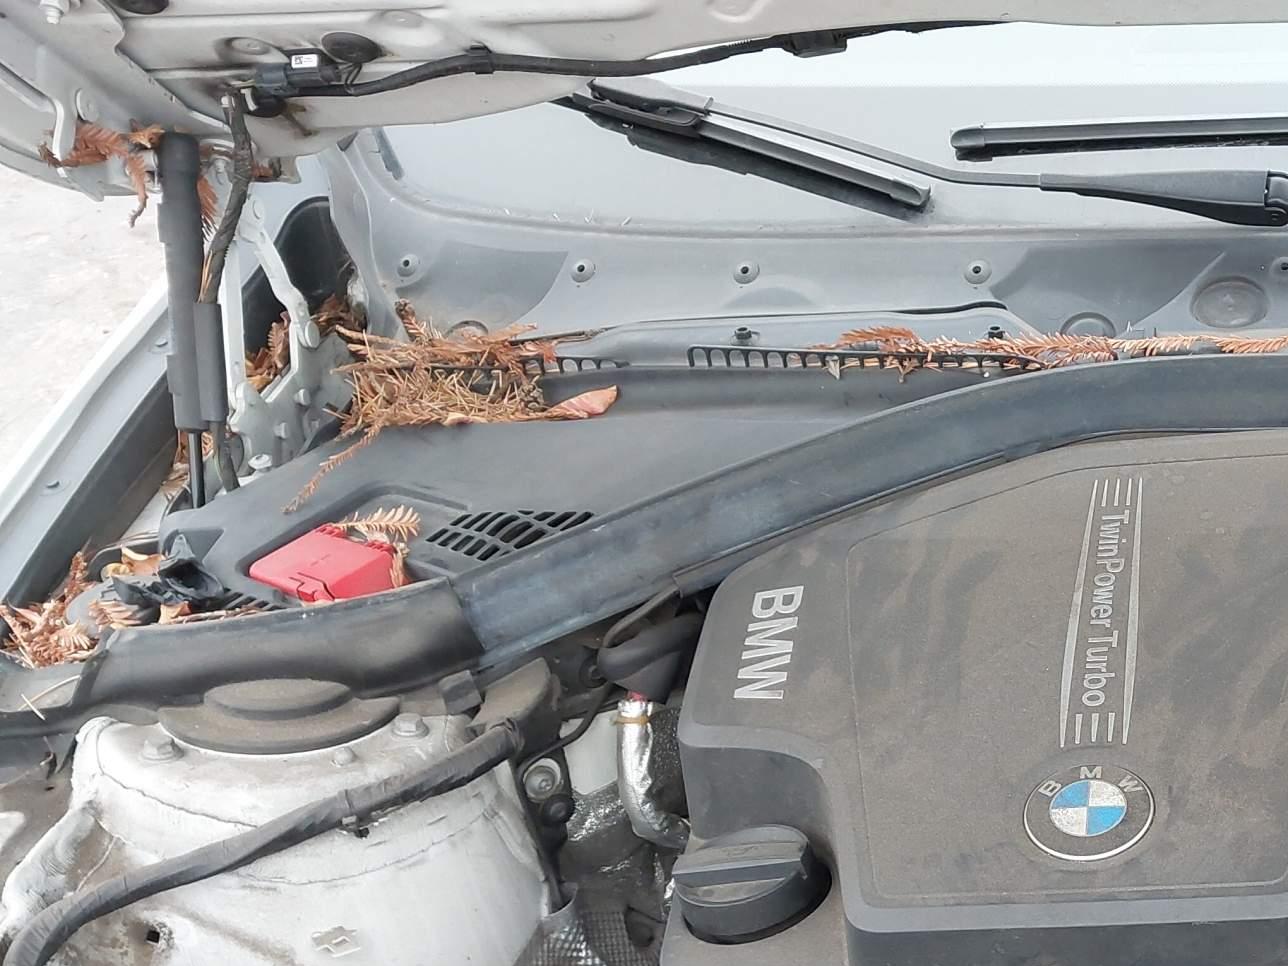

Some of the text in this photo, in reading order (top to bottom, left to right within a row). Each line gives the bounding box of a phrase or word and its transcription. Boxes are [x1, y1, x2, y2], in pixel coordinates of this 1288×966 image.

[733, 585, 804, 700] BMW
[1081, 509, 1130, 707] TwinPower Turbo
[1038, 766, 1144, 797] BMW
